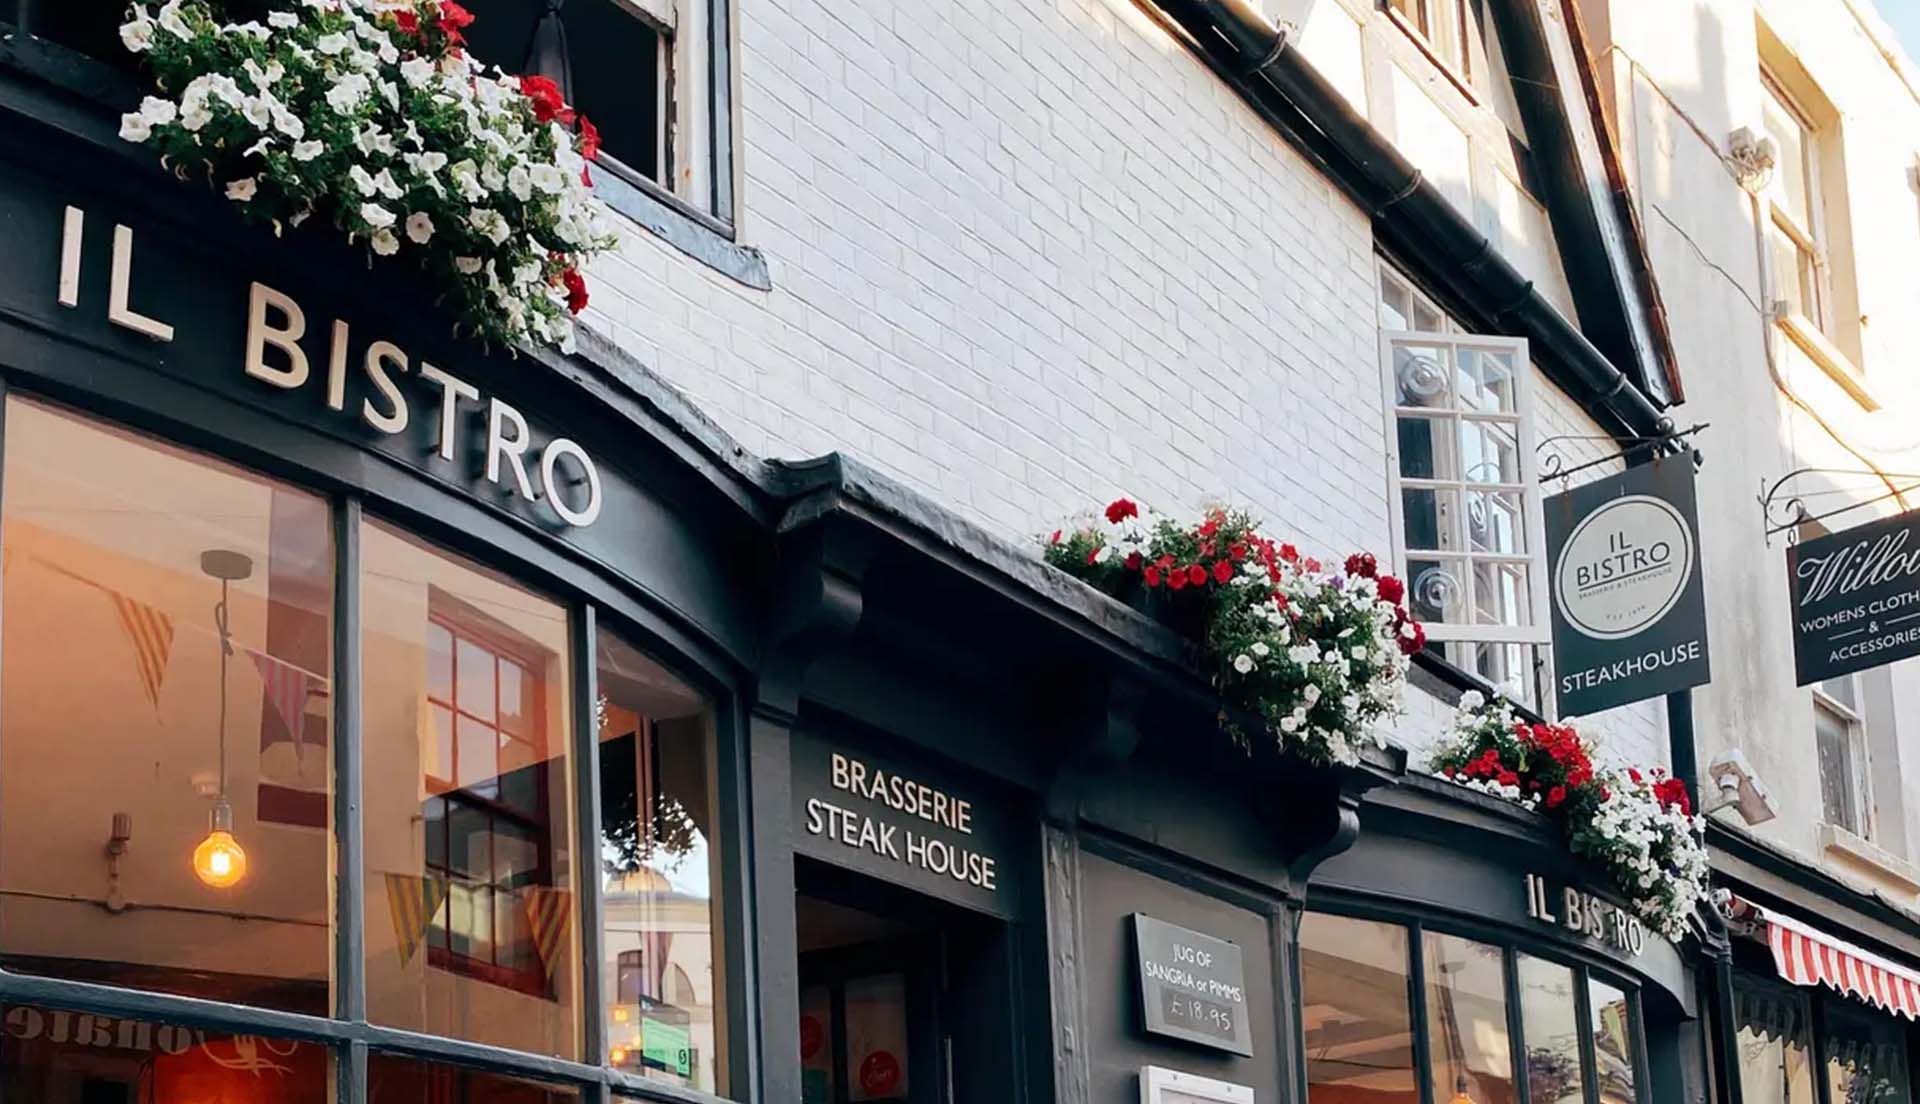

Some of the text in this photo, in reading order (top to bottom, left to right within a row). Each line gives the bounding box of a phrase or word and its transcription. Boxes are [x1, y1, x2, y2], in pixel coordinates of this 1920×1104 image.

[59, 205, 602, 527] IL BISTRO
[1577, 541, 1670, 586] BISTRO
[1609, 531, 1632, 552] IL
[1800, 606, 1865, 633] WOMENS
[1868, 621, 1879, 634] &
[1562, 640, 1700, 693] STEAKHOUSE
[831, 752, 972, 834] BRASSERIE
[806, 799, 996, 890] STEAK HOUSE
[1526, 873, 1556, 923] IL
[1173, 943, 1212, 967] JUG OF
[1145, 961, 1241, 1002] SANGRIA or PIMMS
